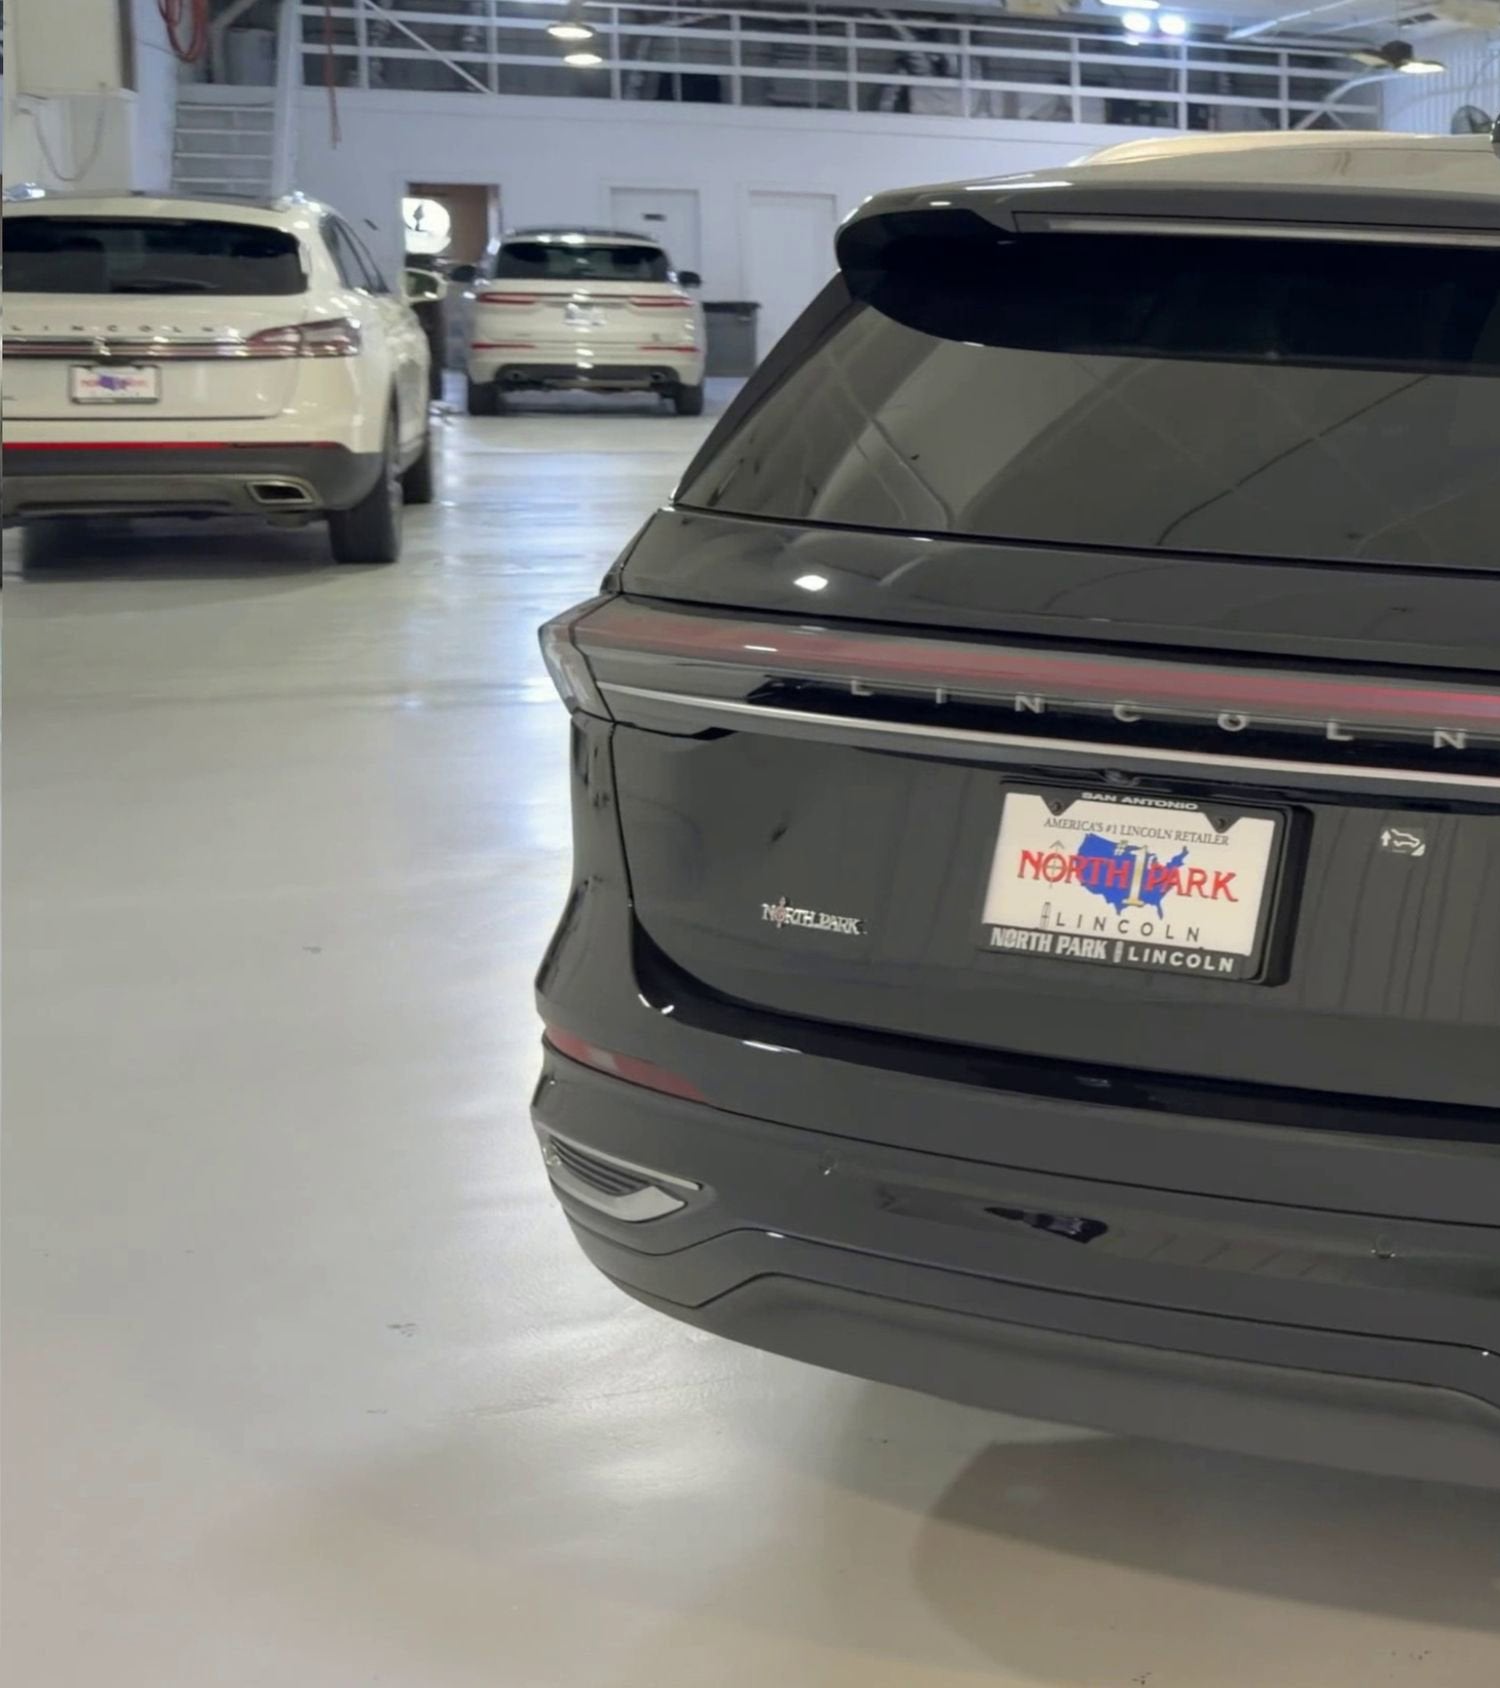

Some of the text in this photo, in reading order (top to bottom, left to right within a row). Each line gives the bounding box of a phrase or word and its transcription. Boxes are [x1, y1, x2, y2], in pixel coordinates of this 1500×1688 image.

[850, 677, 1468, 751] LINCOLN
[1080, 791, 1199, 811] SAN ANTONIO
[1044, 817, 1230, 847] AMERICA'S #1 LINCOLN RETAILER
[1017, 850, 1239, 902] NORTH PARK
[818, 912, 861, 935] PARK
[1056, 912, 1201, 942] LINCOLN
[990, 927, 1234, 973] NORTH PARK LINCOLN
